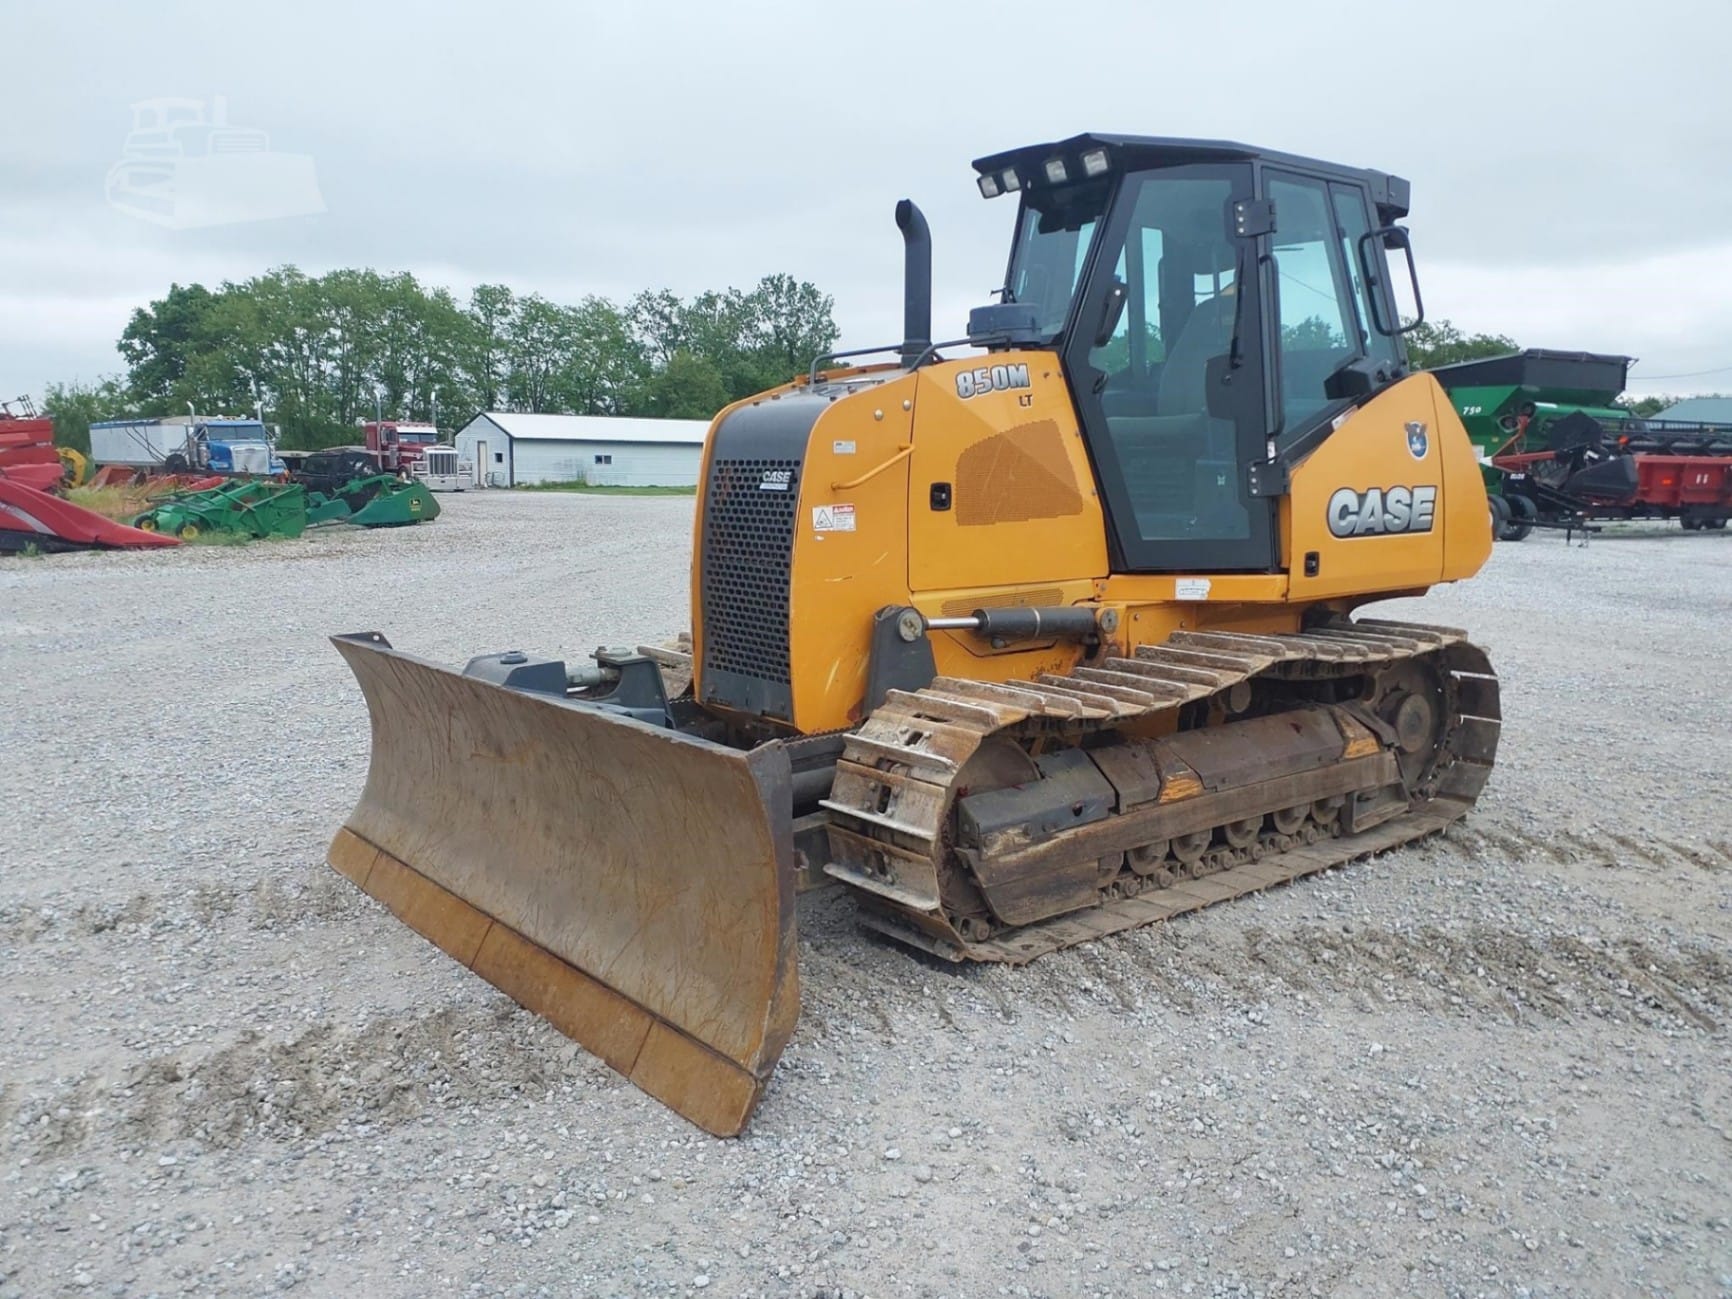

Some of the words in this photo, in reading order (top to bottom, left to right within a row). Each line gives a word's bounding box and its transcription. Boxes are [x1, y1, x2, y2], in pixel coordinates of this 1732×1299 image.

[956, 364, 1030, 399] 850M
[1019, 394, 1033, 407] LT
[1463, 406, 1482, 415] 750
[763, 471, 792, 482] CASE
[1327, 485, 1437, 538] CASE
